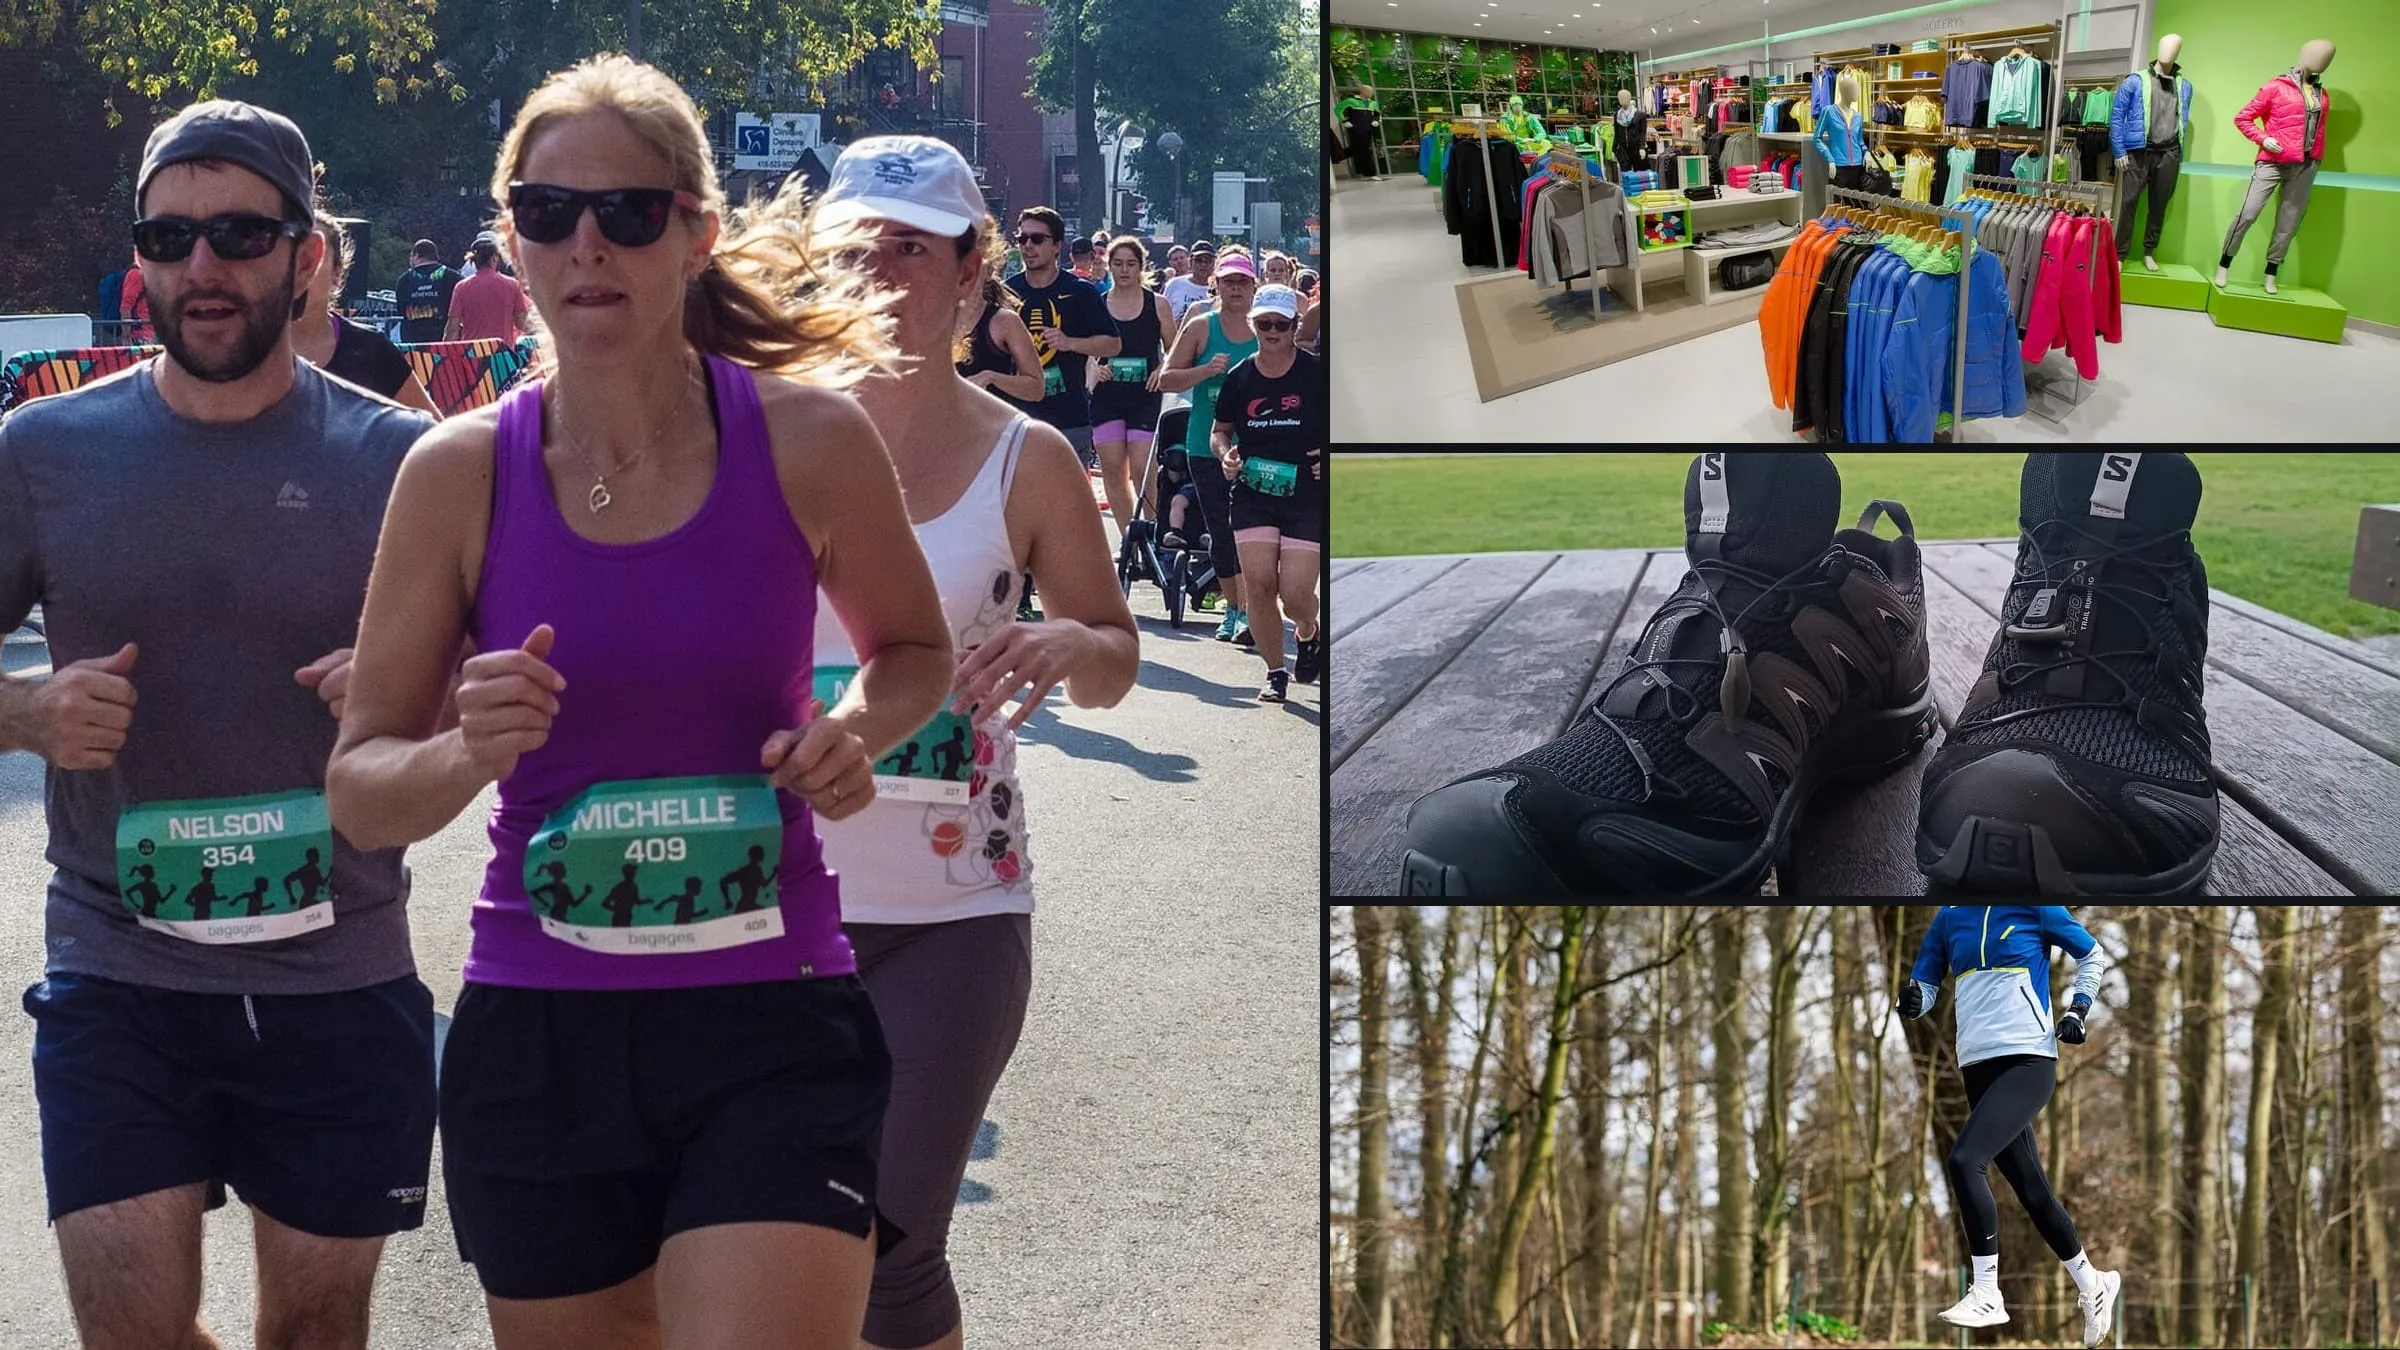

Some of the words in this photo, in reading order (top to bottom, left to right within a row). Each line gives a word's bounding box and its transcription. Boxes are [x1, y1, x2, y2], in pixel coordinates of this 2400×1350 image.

[2080, 610, 2090, 631] TRAIL
[572, 795, 736, 832] MICHELLE
[168, 809, 285, 840] NELSON
[203, 844, 255, 868] 354
[624, 836, 687, 864] 409
[304, 911, 323, 924] 354
[744, 918, 768, 932] 409
[207, 923, 265, 939] bagages
[628, 932, 696, 947] bagages
